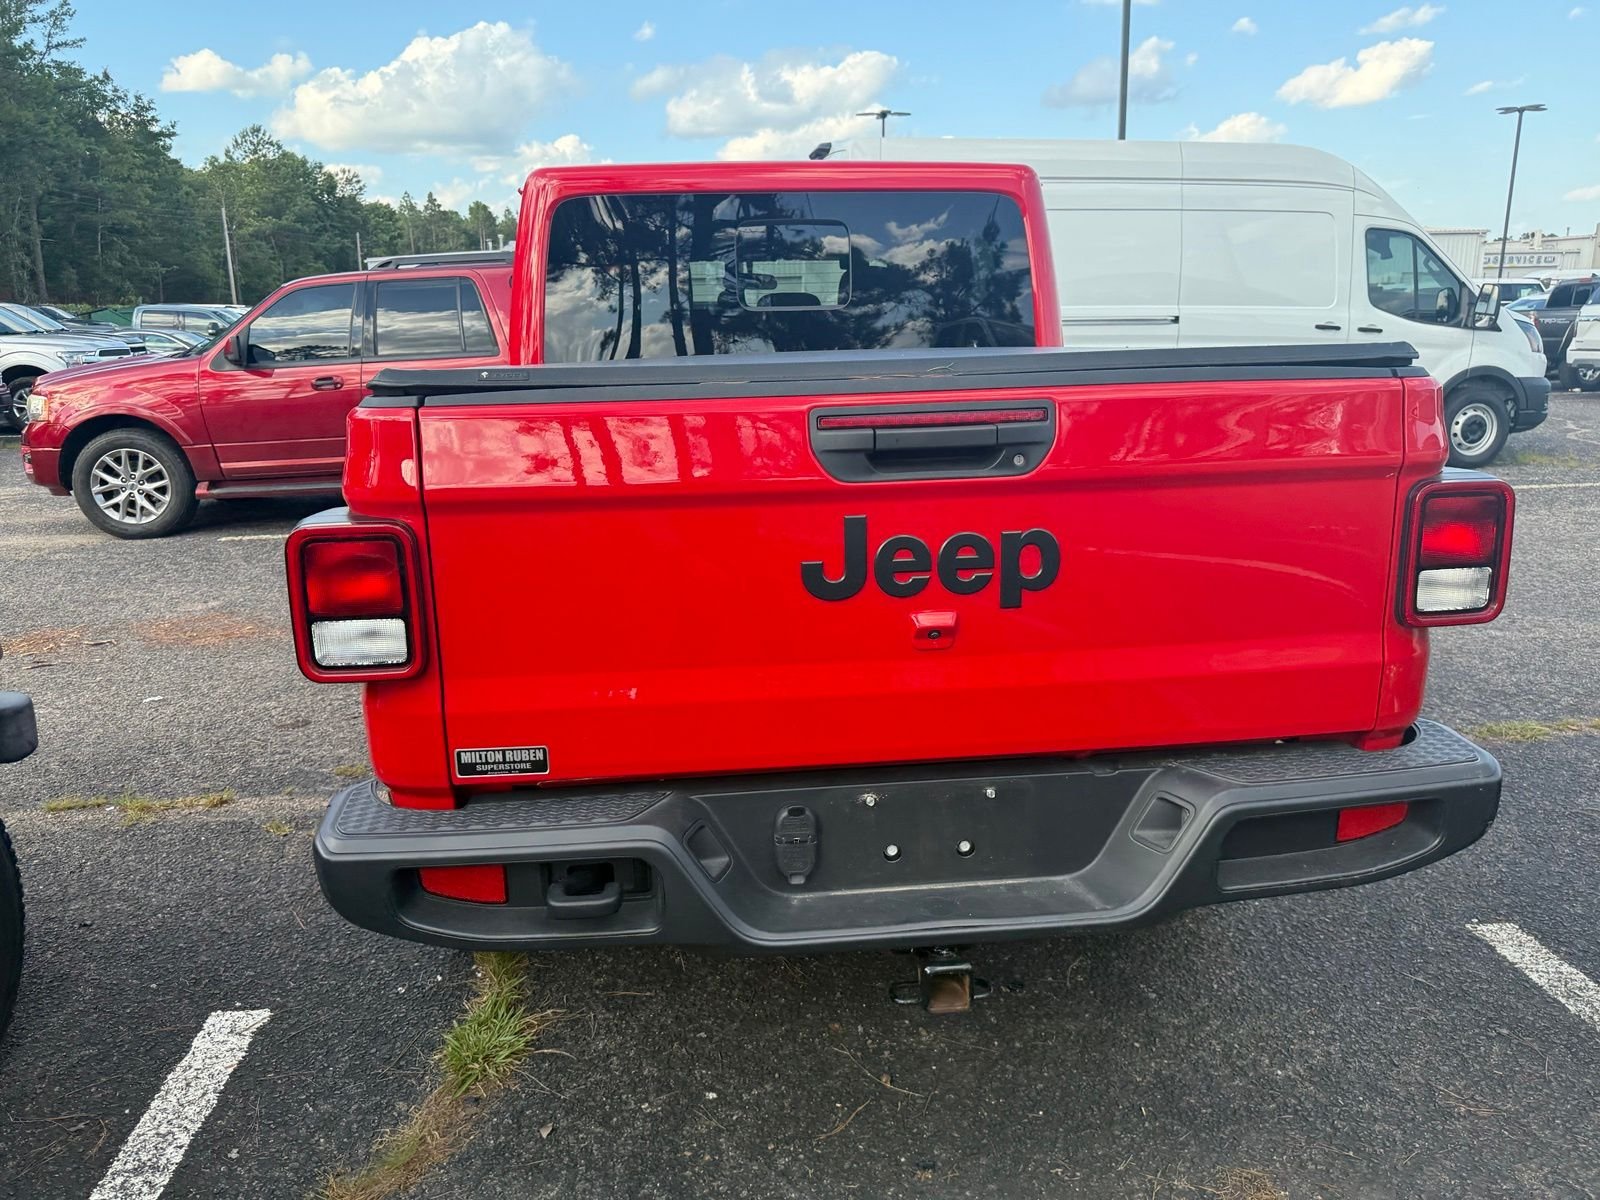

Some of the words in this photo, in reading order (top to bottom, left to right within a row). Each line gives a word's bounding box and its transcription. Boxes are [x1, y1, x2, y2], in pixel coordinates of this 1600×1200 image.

[1492, 255, 1542, 265] SRVICE
[801, 515, 1060, 608] Jeep
[460, 751, 503, 763] MILTON
[505, 749, 543, 761] RUBEN
[476, 763, 532, 771] SUPERSTORE
